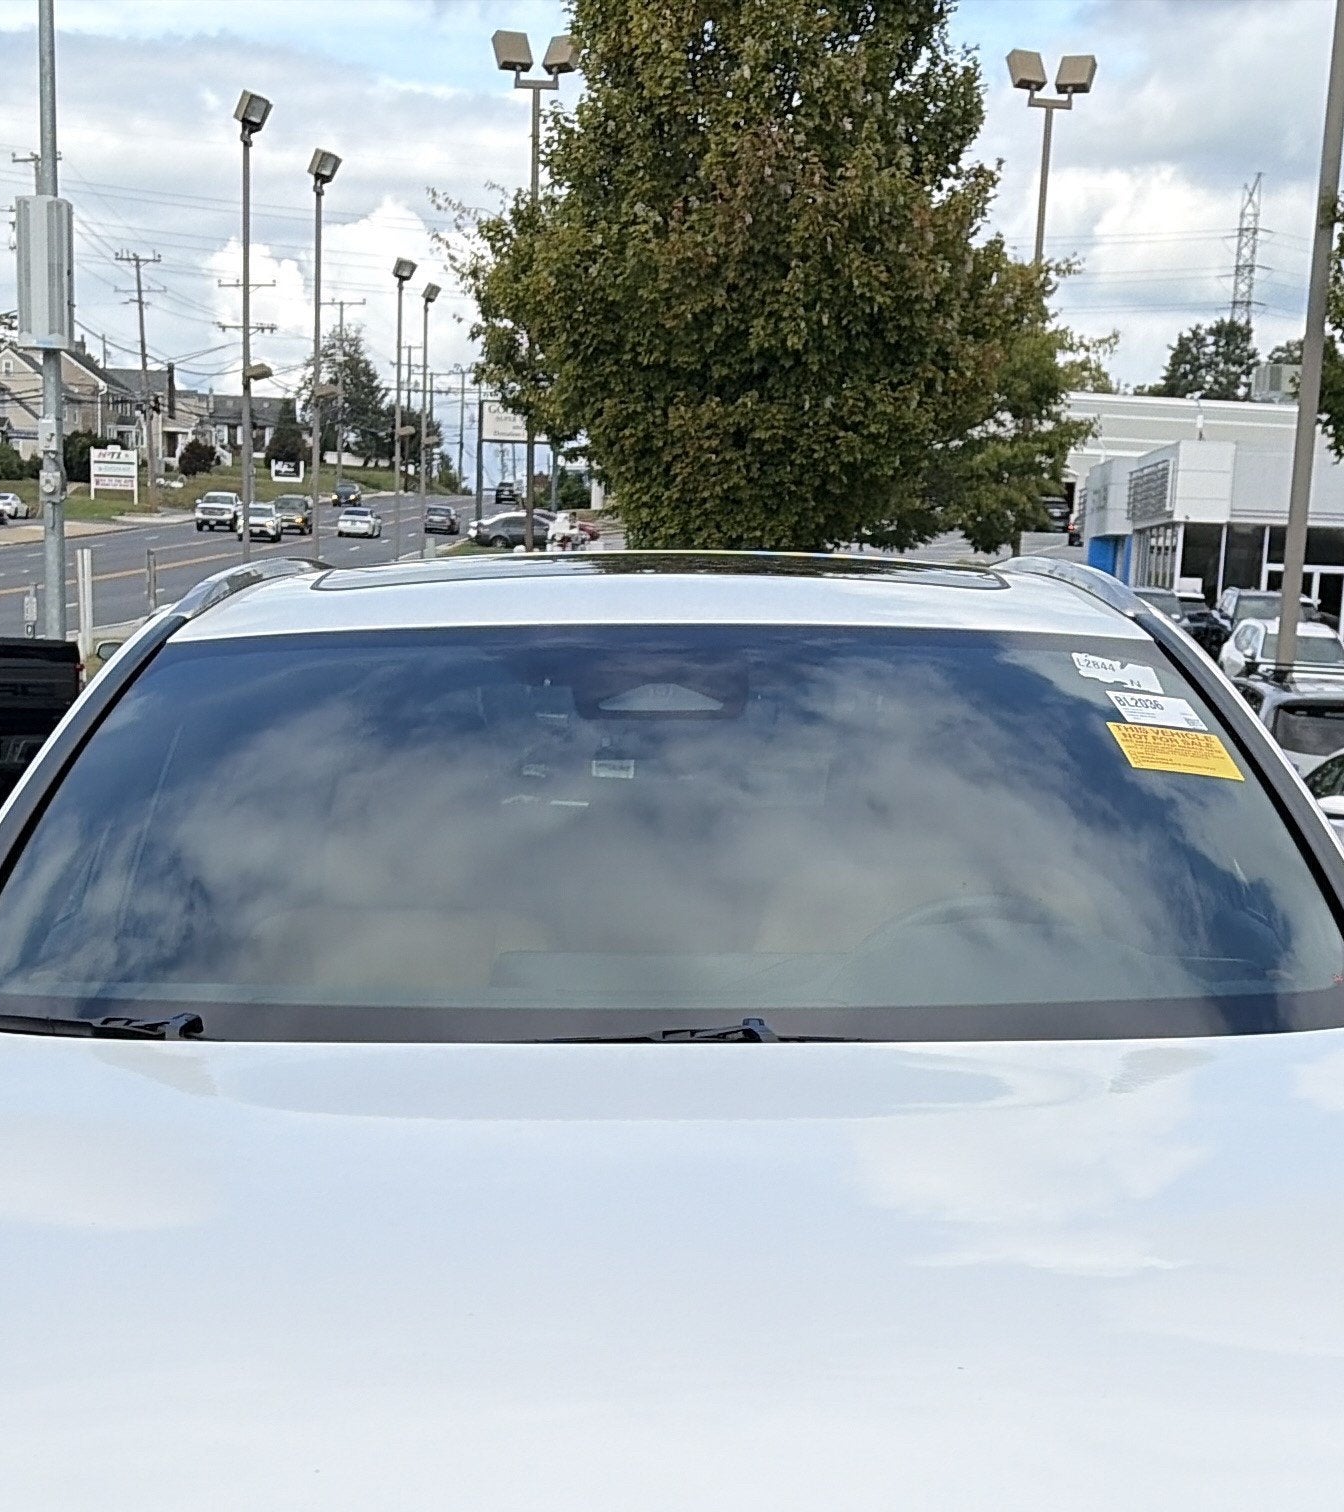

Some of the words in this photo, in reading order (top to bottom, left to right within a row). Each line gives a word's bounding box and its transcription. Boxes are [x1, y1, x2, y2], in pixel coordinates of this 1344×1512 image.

[1114, 696, 1165, 711] BL2036
[1121, 732, 1150, 741] NOT
[1152, 735, 1180, 745] FOR
[1182, 738, 1214, 748] SALE
[1150, 727, 1215, 743] VEHICLE
